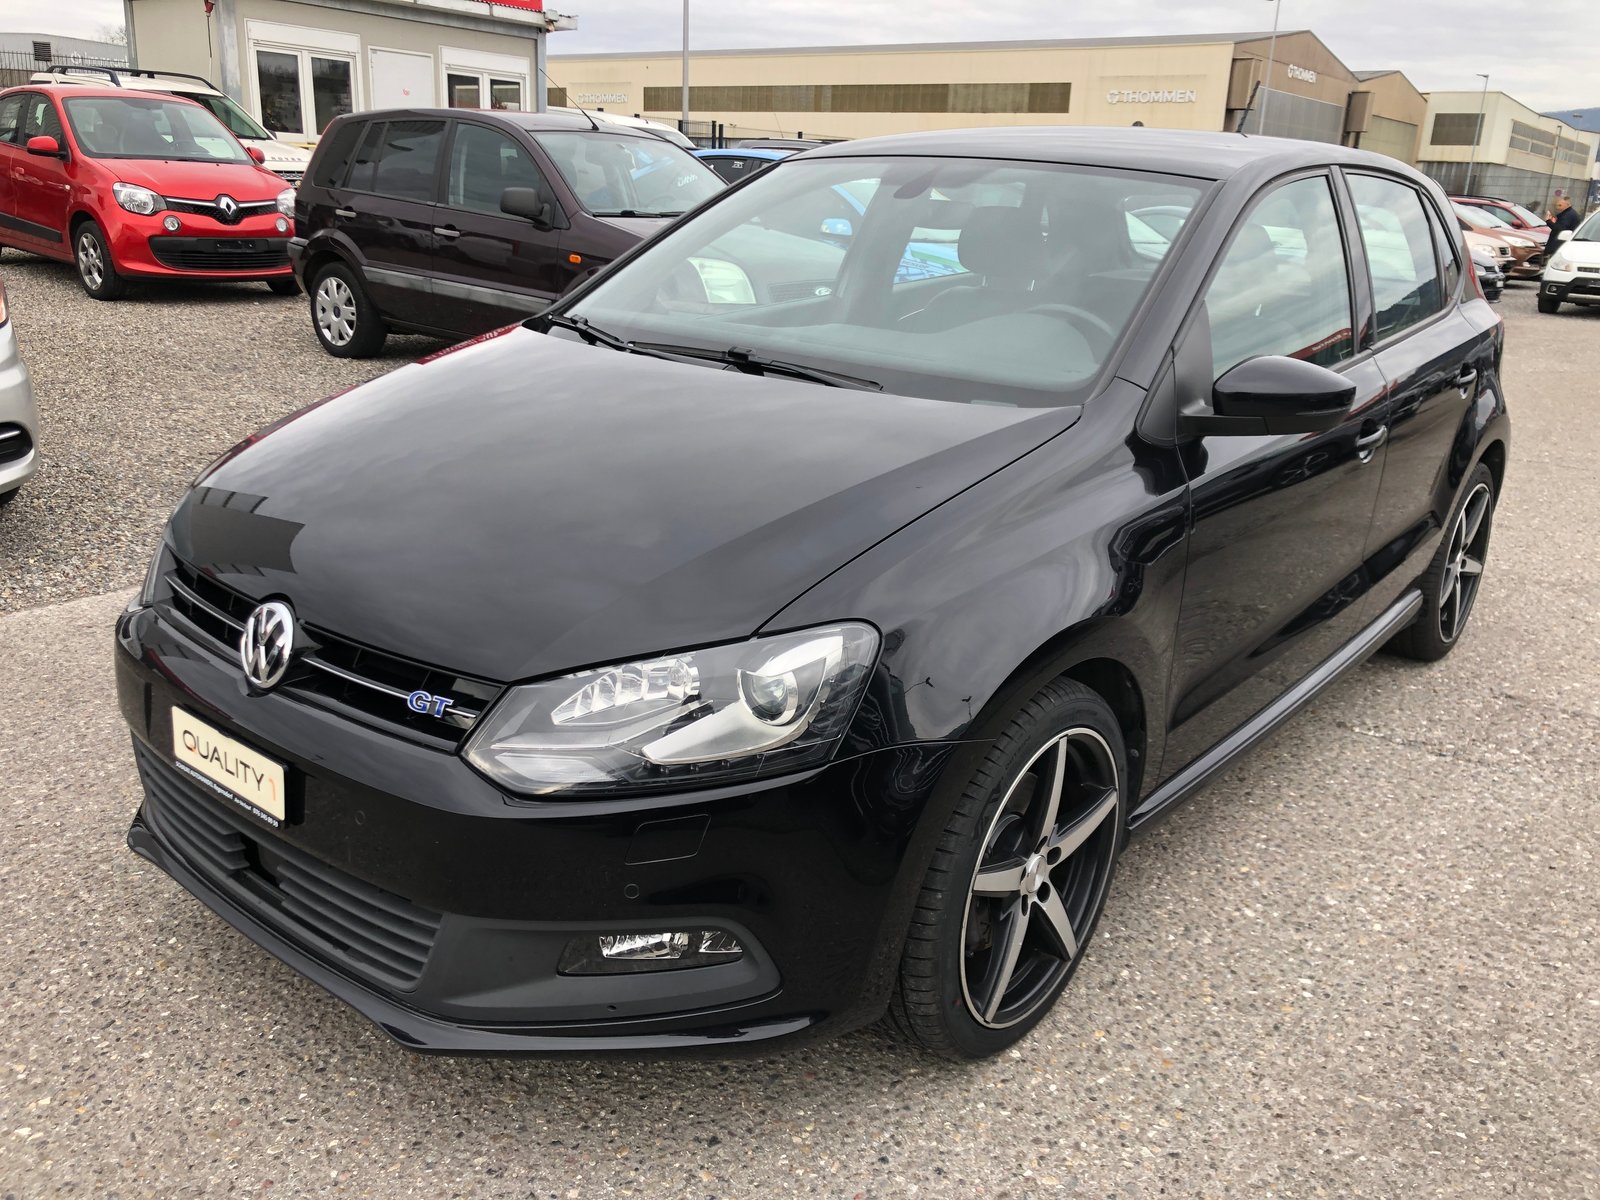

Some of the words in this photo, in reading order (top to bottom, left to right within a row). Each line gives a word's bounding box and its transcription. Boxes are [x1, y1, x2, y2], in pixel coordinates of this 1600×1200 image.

[1292, 65, 1317, 84] THOMMEN
[582, 93, 628, 103] THOMMEN
[1121, 90, 1197, 104] THOMMEN
[407, 690, 455, 718] GT
[182, 729, 265, 792] QUALITY
[268, 776, 277, 802] 1
